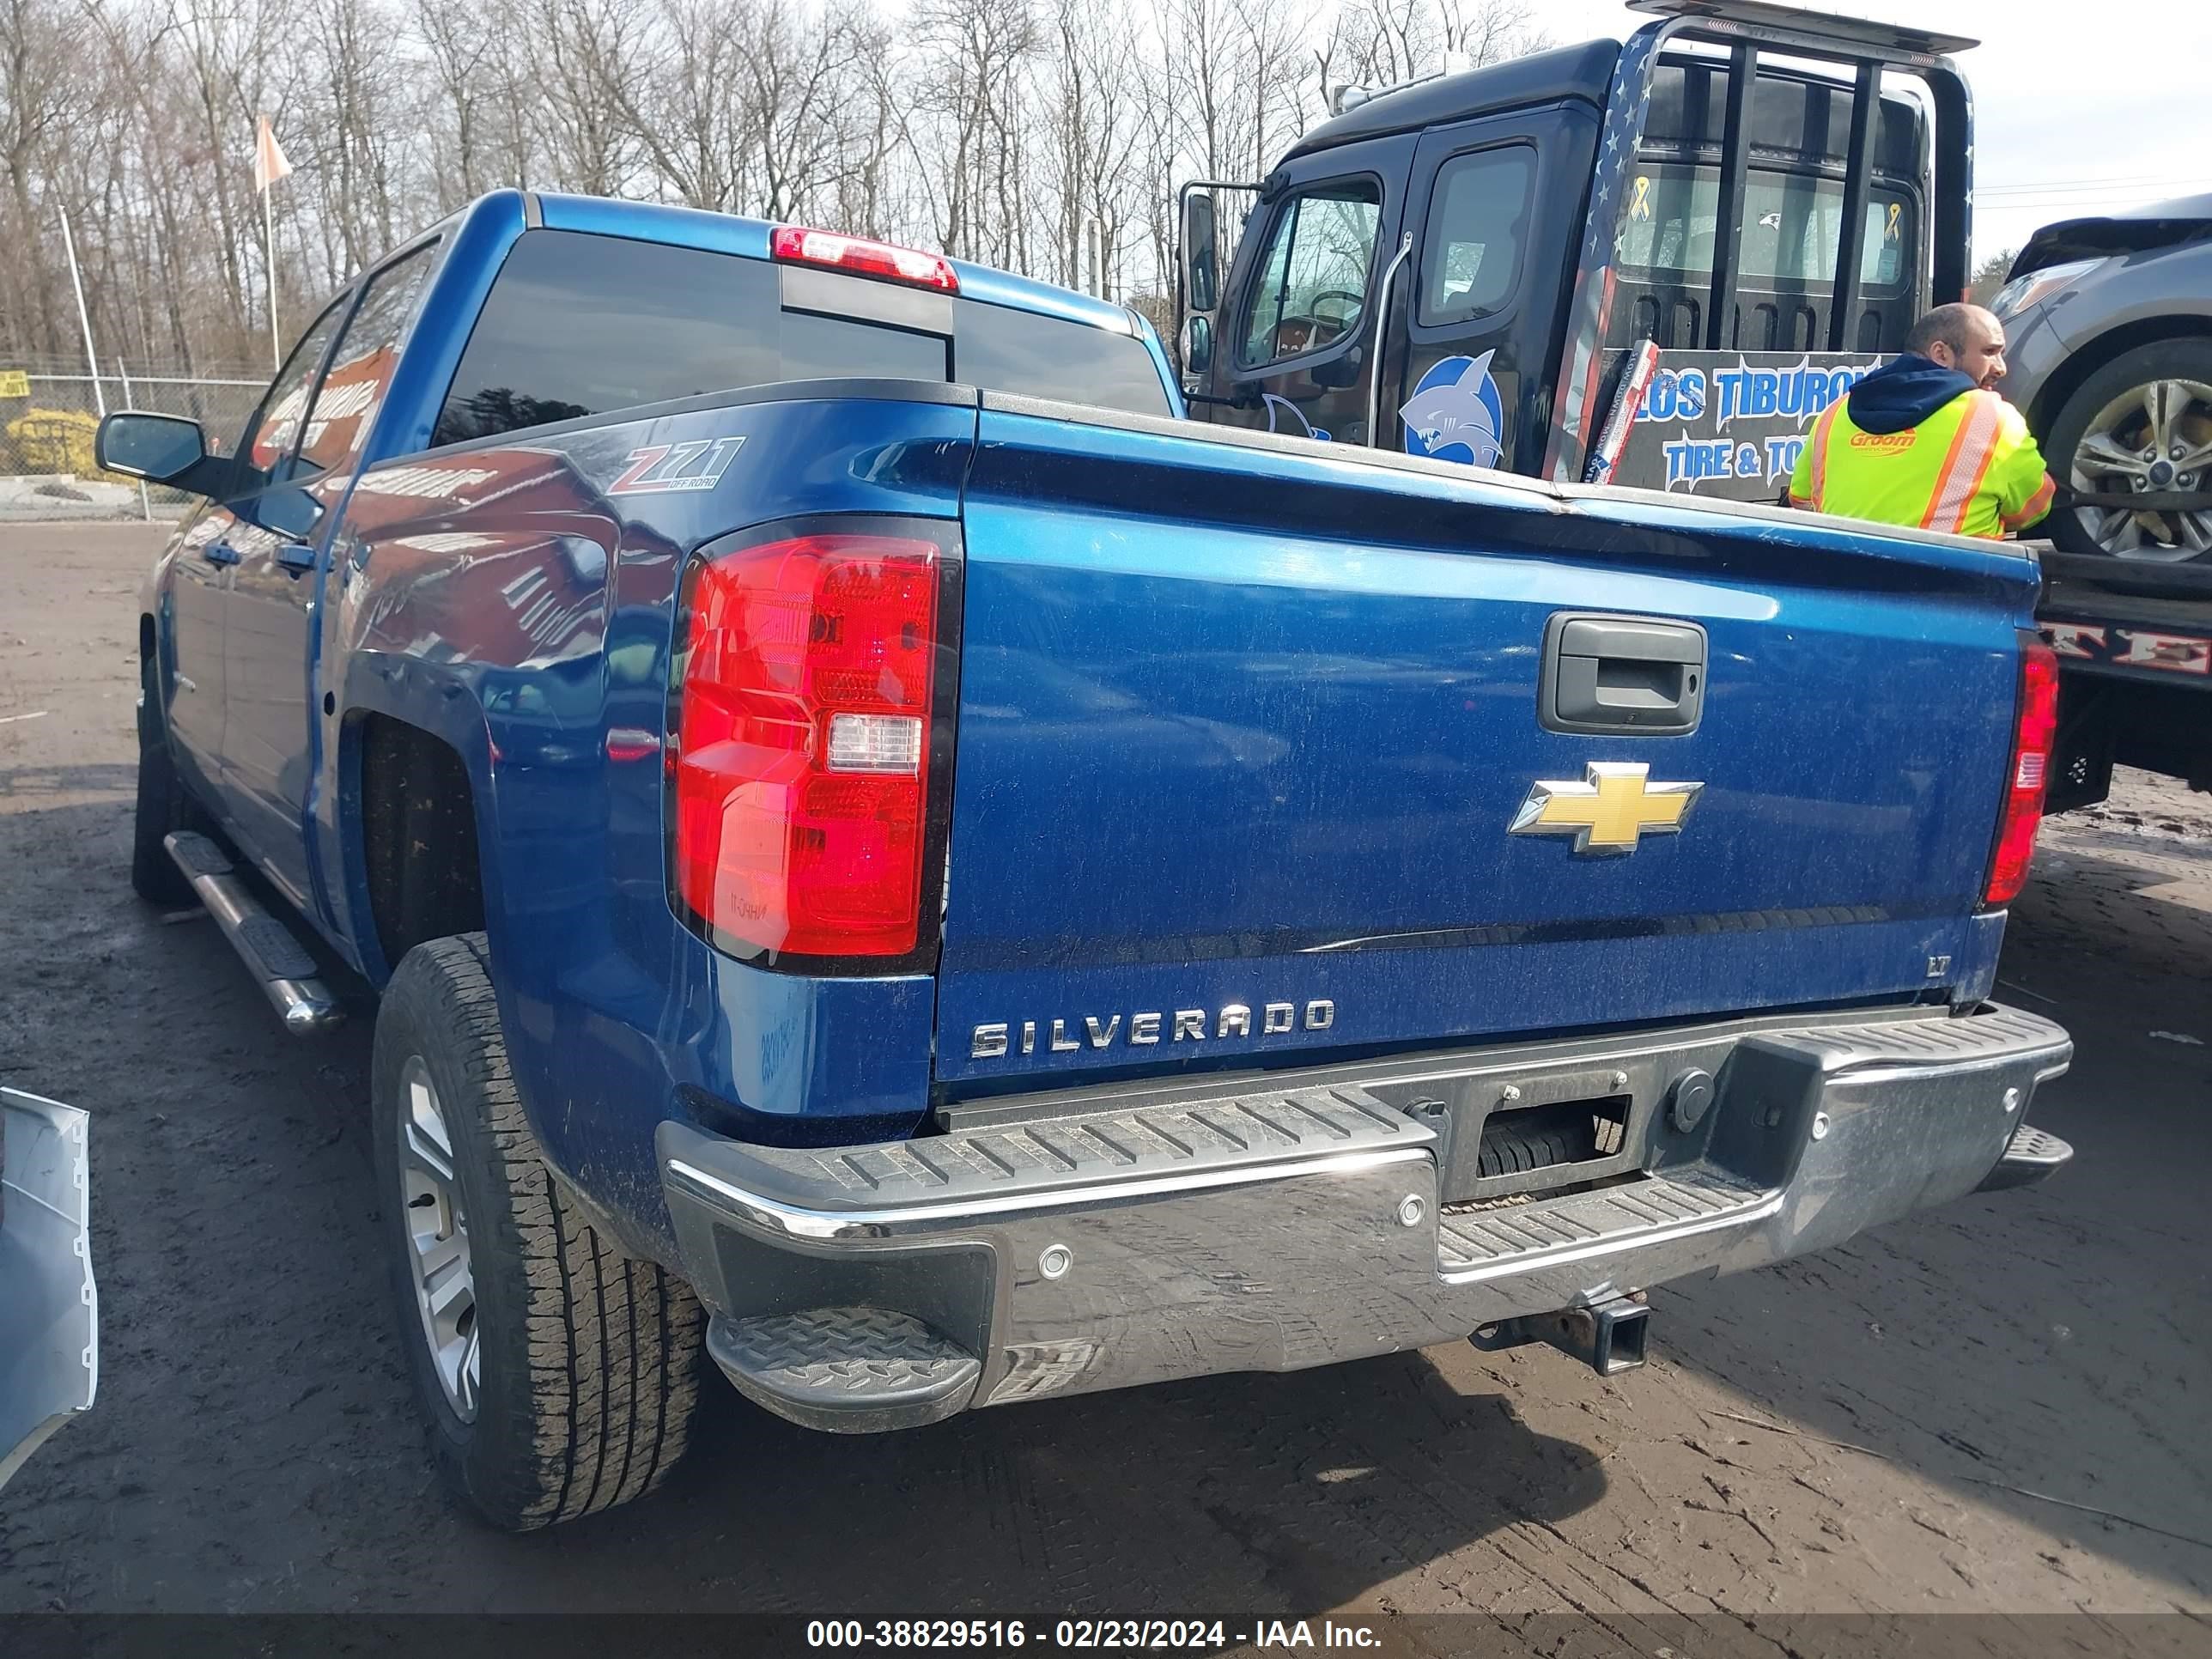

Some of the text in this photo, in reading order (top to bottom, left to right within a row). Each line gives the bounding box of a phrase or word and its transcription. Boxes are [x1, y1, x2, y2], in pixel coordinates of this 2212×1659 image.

[605, 435, 749, 495] Z71
[1662, 428, 1809, 493] TIRE & TO
[1850, 431, 1917, 447] Groom
[688, 477, 716, 488] ROAD
[971, 999, 1335, 1059] SILVERADO
